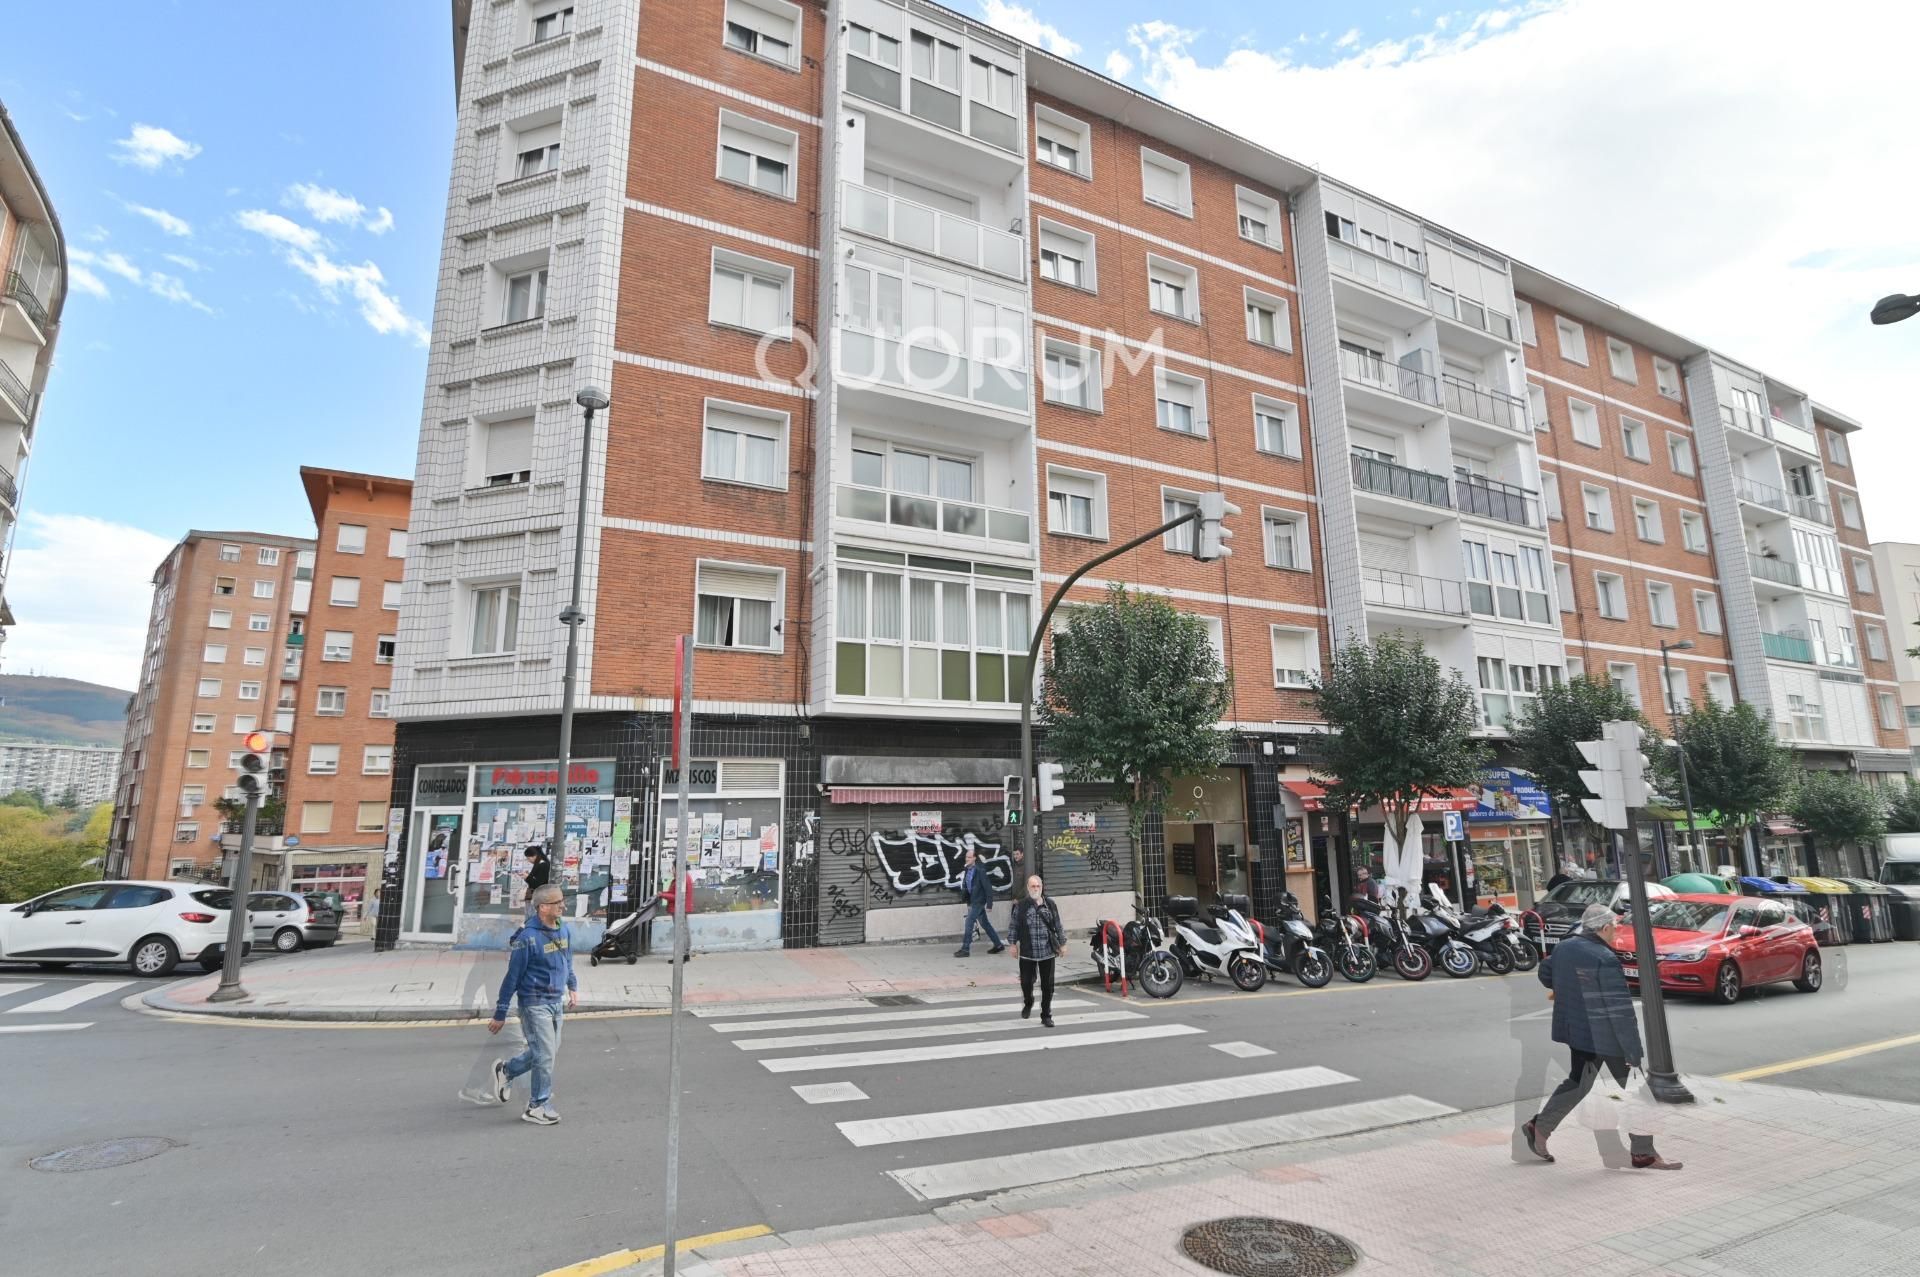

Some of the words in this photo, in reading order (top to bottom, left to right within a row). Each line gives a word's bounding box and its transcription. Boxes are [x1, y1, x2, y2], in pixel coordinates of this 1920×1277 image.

[664, 769, 717, 784] MAISCOS
[418, 778, 467, 794] CONGELADOS
[490, 787, 536, 796] PESCADOS
[539, 787, 546, 795] Y
[547, 786, 597, 795] MRISCOS
[1445, 815, 1457, 837] P
